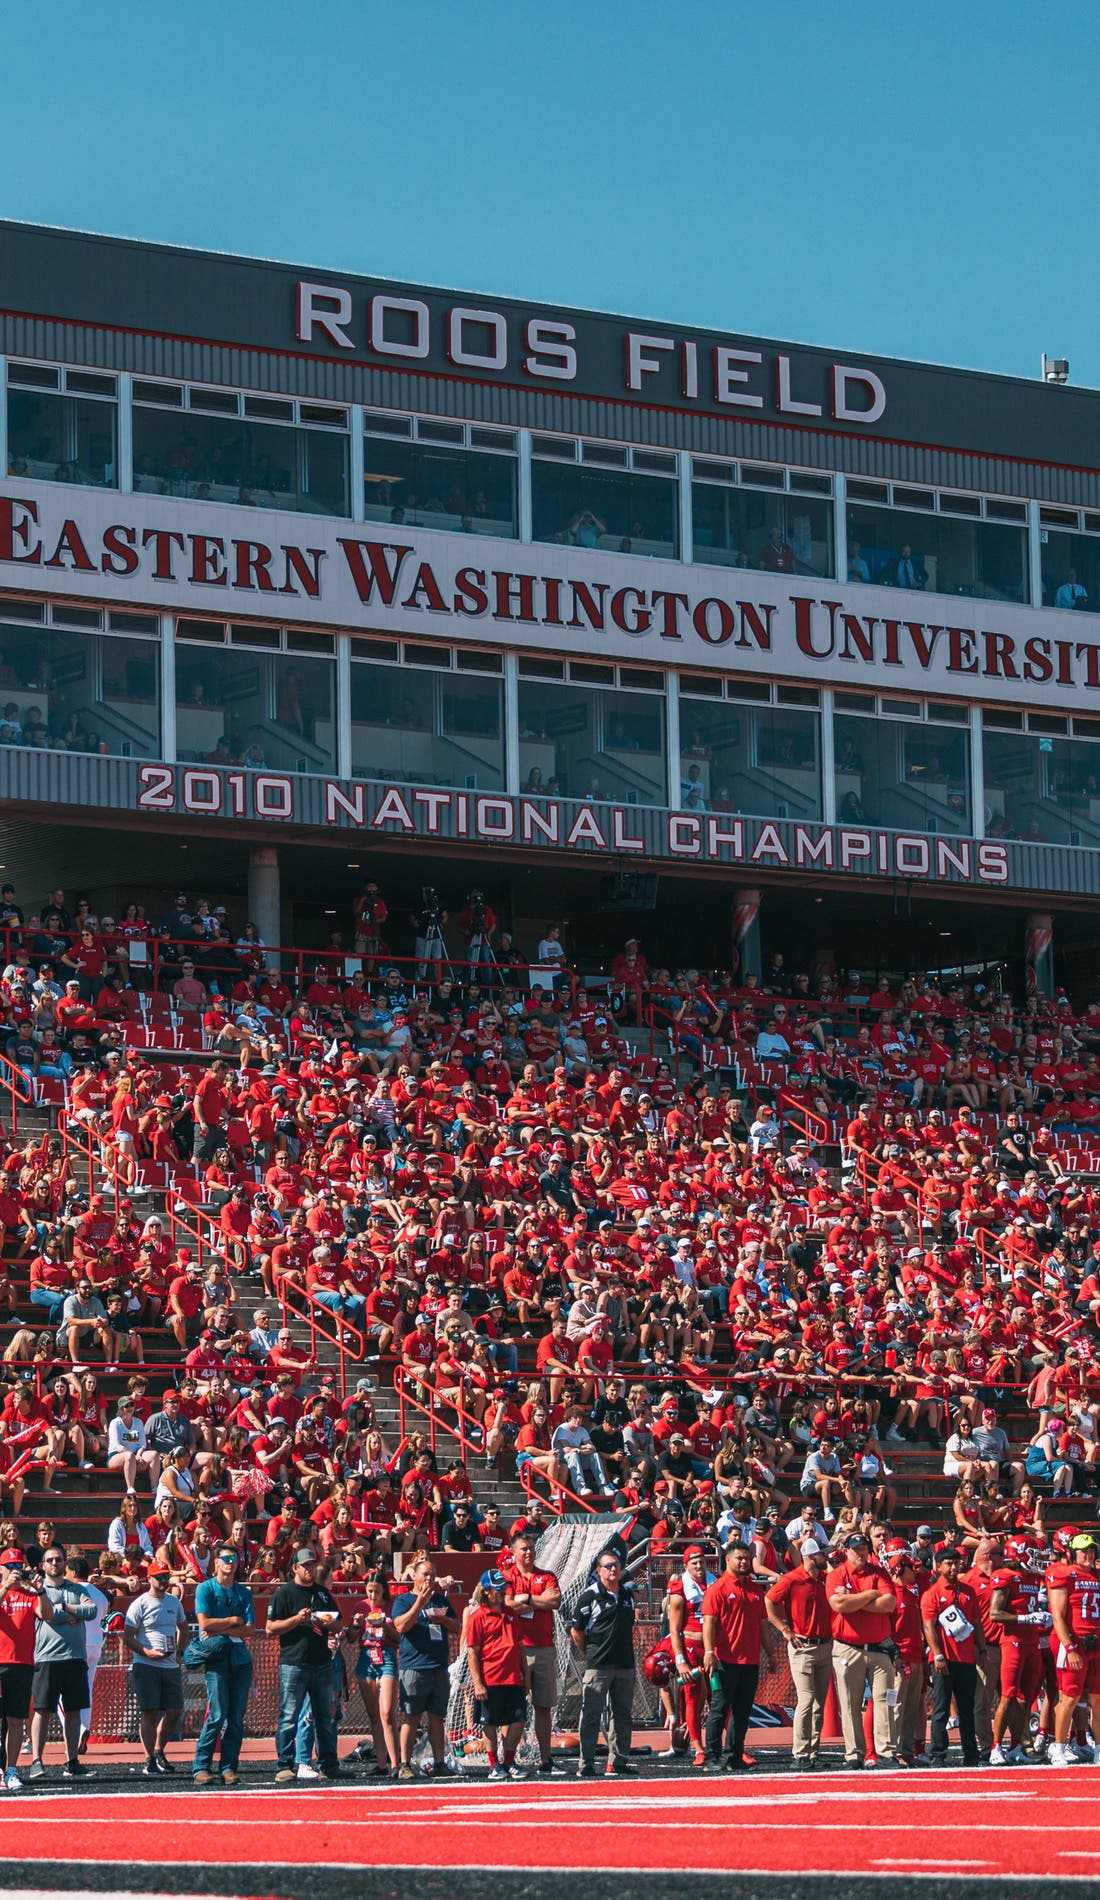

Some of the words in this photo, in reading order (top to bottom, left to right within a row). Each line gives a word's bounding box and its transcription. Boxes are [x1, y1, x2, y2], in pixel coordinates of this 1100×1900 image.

[296, 281, 577, 380] ROOS
[626, 332, 887, 423] FIELD
[0, 497, 326, 598] EASTERN
[336, 537, 777, 653] WASHINGTON
[136, 764, 295, 820] 2010
[326, 780, 645, 852] NATIONAL
[667, 812, 1010, 883] CHAMPIONS
[630, 1186, 649, 1200] 10
